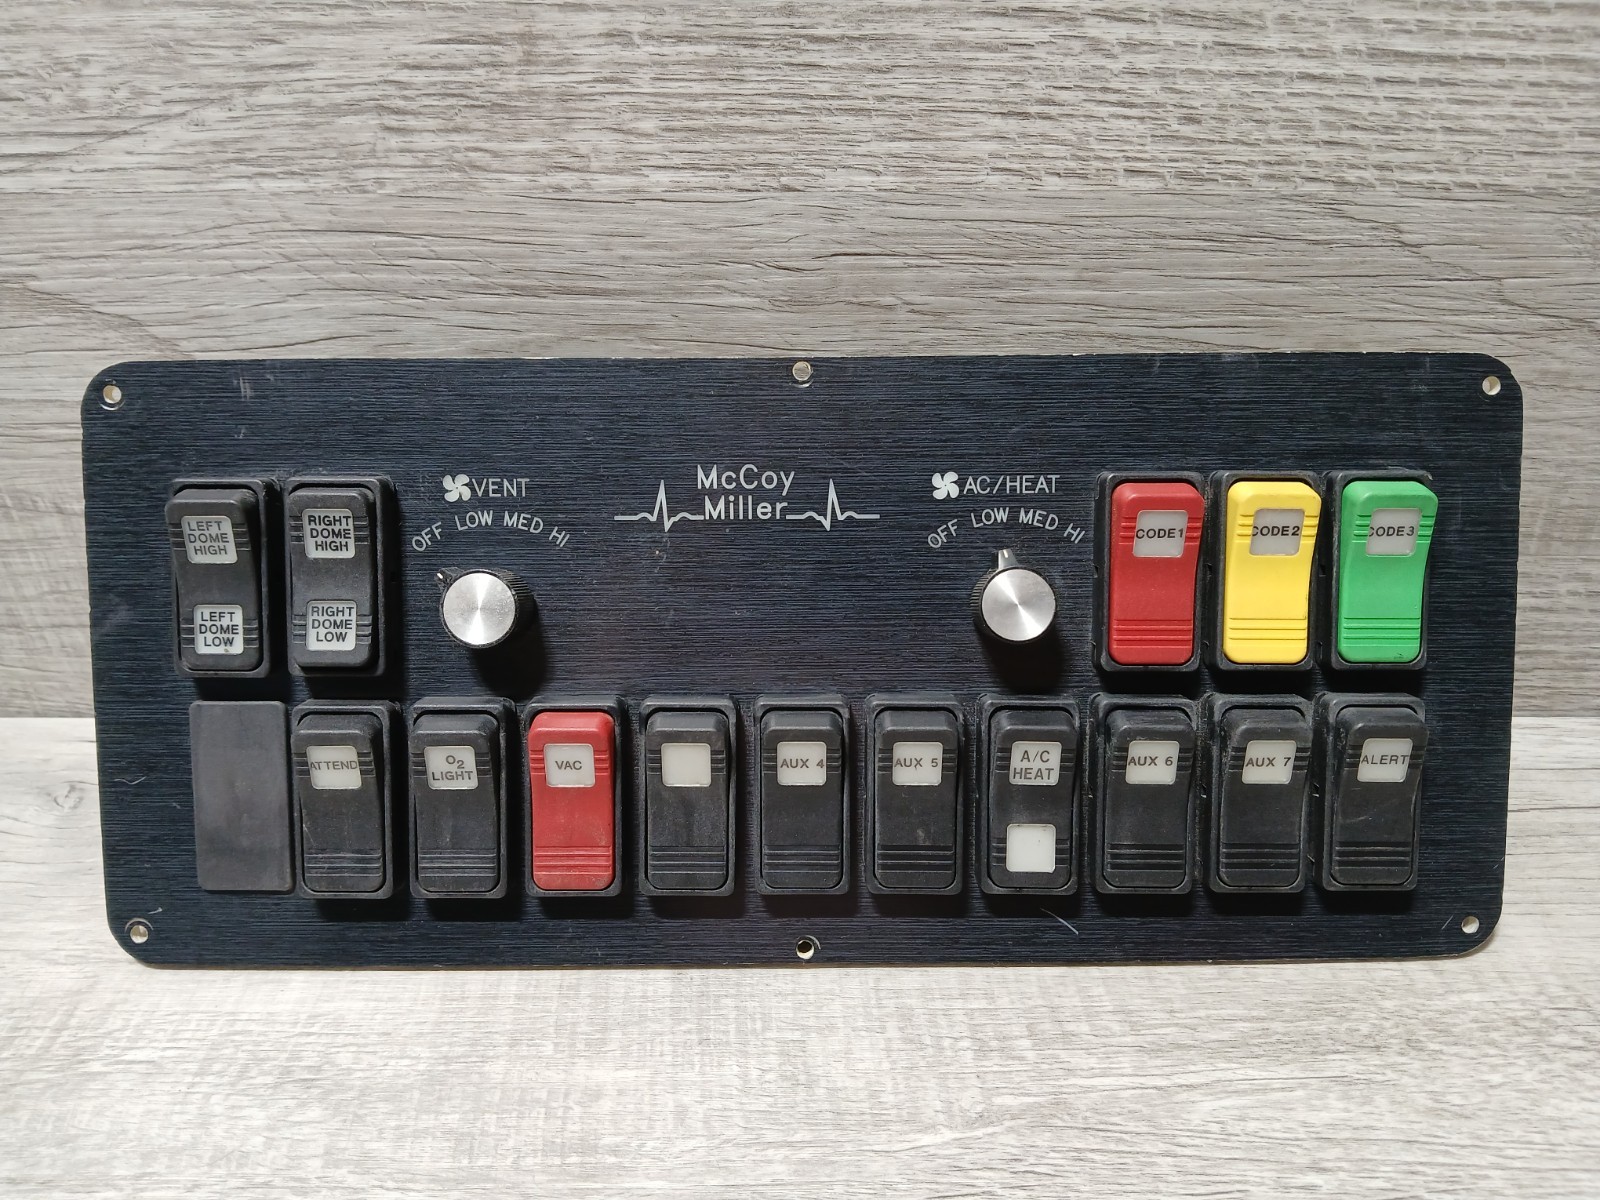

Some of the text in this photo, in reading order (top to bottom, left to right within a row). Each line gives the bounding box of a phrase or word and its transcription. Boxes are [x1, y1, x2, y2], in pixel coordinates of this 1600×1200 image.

[697, 463, 795, 496] McCoy
[963, 475, 1061, 495] AC/HEAT
[471, 478, 530, 498] VENT
[704, 495, 788, 520] Miller
[187, 520, 222, 532] LEFT
[307, 514, 352, 527] RIGHT
[310, 528, 352, 539] DOME
[411, 510, 570, 551] OFF LOW MED HI
[927, 507, 1086, 549] OFF LOW MED HI
[187, 533, 230, 544] DOME
[193, 545, 228, 556] HIGH
[315, 540, 349, 552] HIGH
[200, 611, 236, 622] LEFT
[311, 605, 355, 617] RIGHT
[199, 623, 239, 635] DOME
[311, 618, 353, 630] DOME
[203, 636, 234, 647] LOW
[316, 631, 348, 642] LOW
[1020, 750, 1050, 763] A/C
[1128, 756, 1173, 766] AUX 6
[1245, 757, 1292, 767] AUX 7
[1361, 754, 1409, 765] ALERT
[310, 760, 358, 771] ATTEND
[554, 760, 583, 771] VAC
[780, 758, 826, 769] AUX 4
[894, 757, 939, 769] AUX 5
[431, 770, 474, 782] LIGHT
[1012, 767, 1055, 780] HEAT
